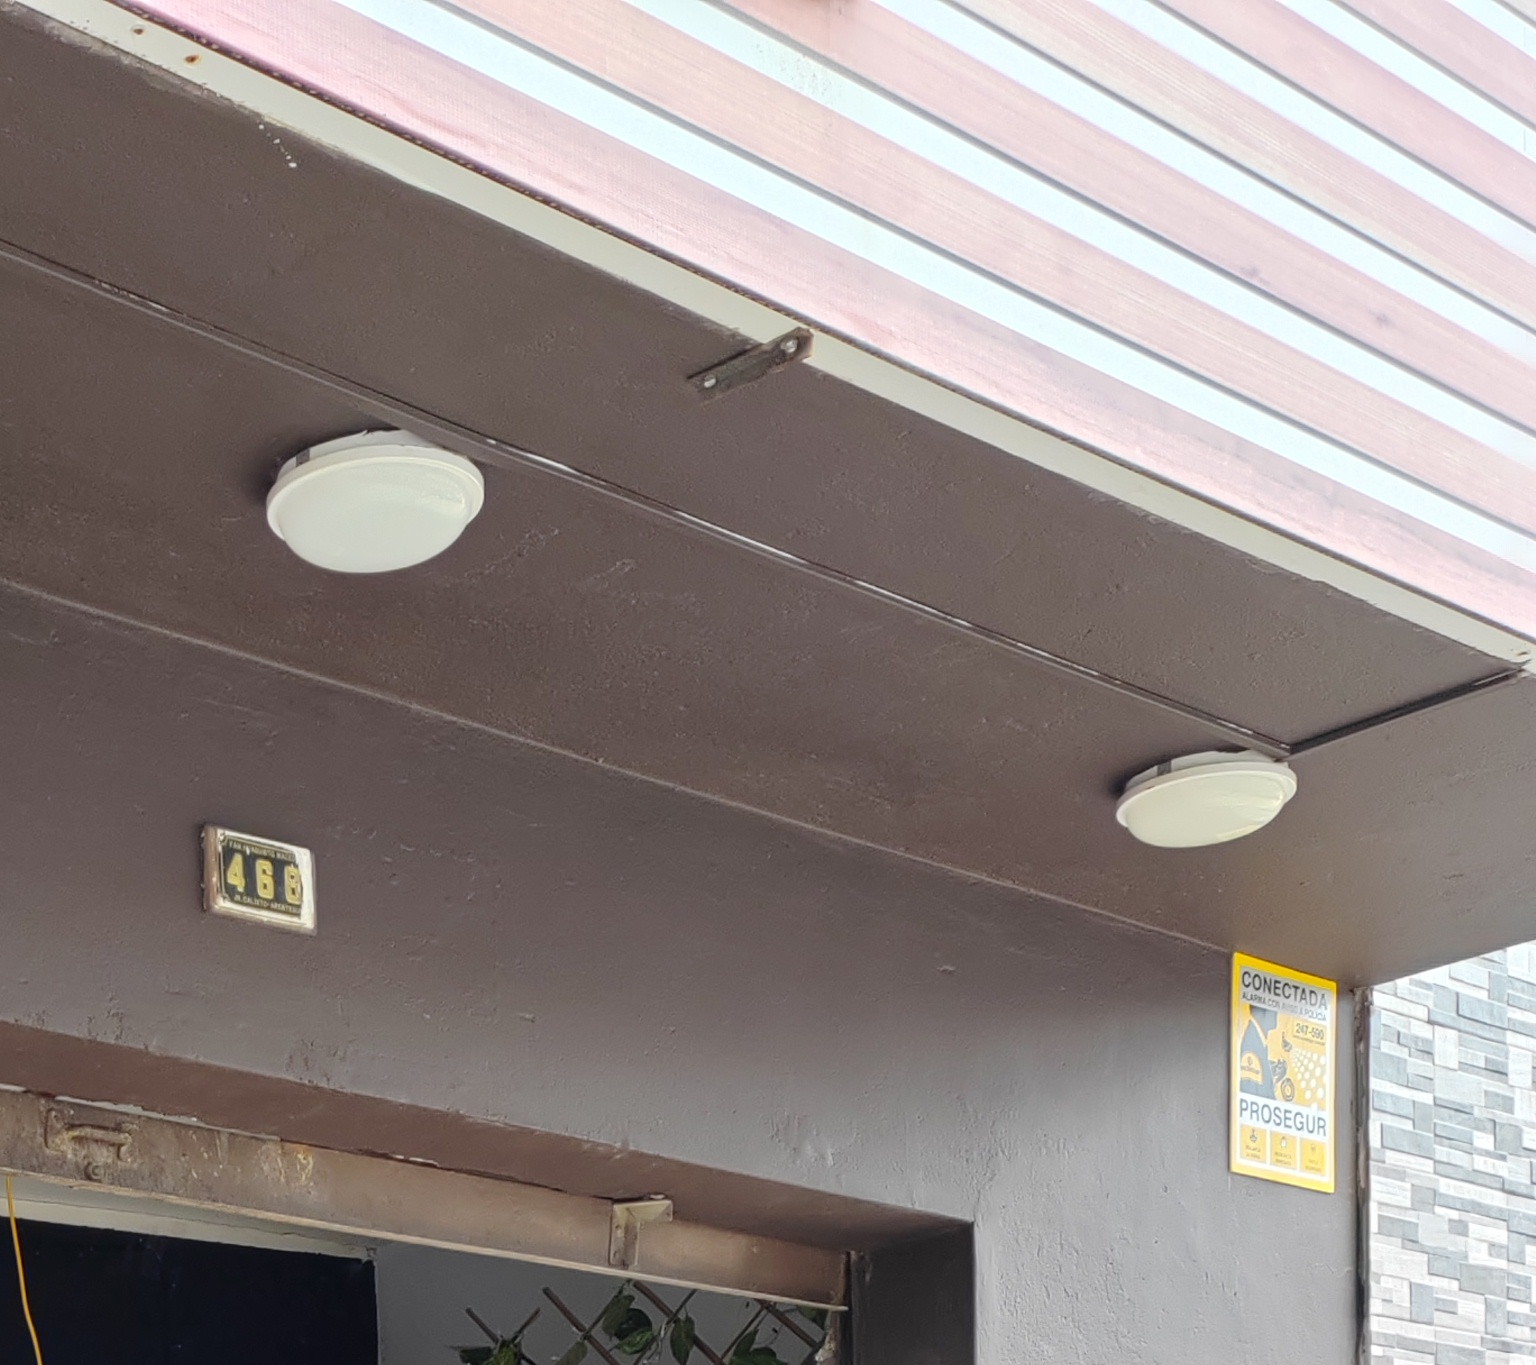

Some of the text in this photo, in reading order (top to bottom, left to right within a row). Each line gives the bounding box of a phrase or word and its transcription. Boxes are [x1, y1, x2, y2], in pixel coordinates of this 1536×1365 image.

[1241, 971, 1328, 1011] CONECTADA
[1241, 992, 1266, 1005] ALARMA
[1239, 1097, 1327, 1137] PROSEGUR
